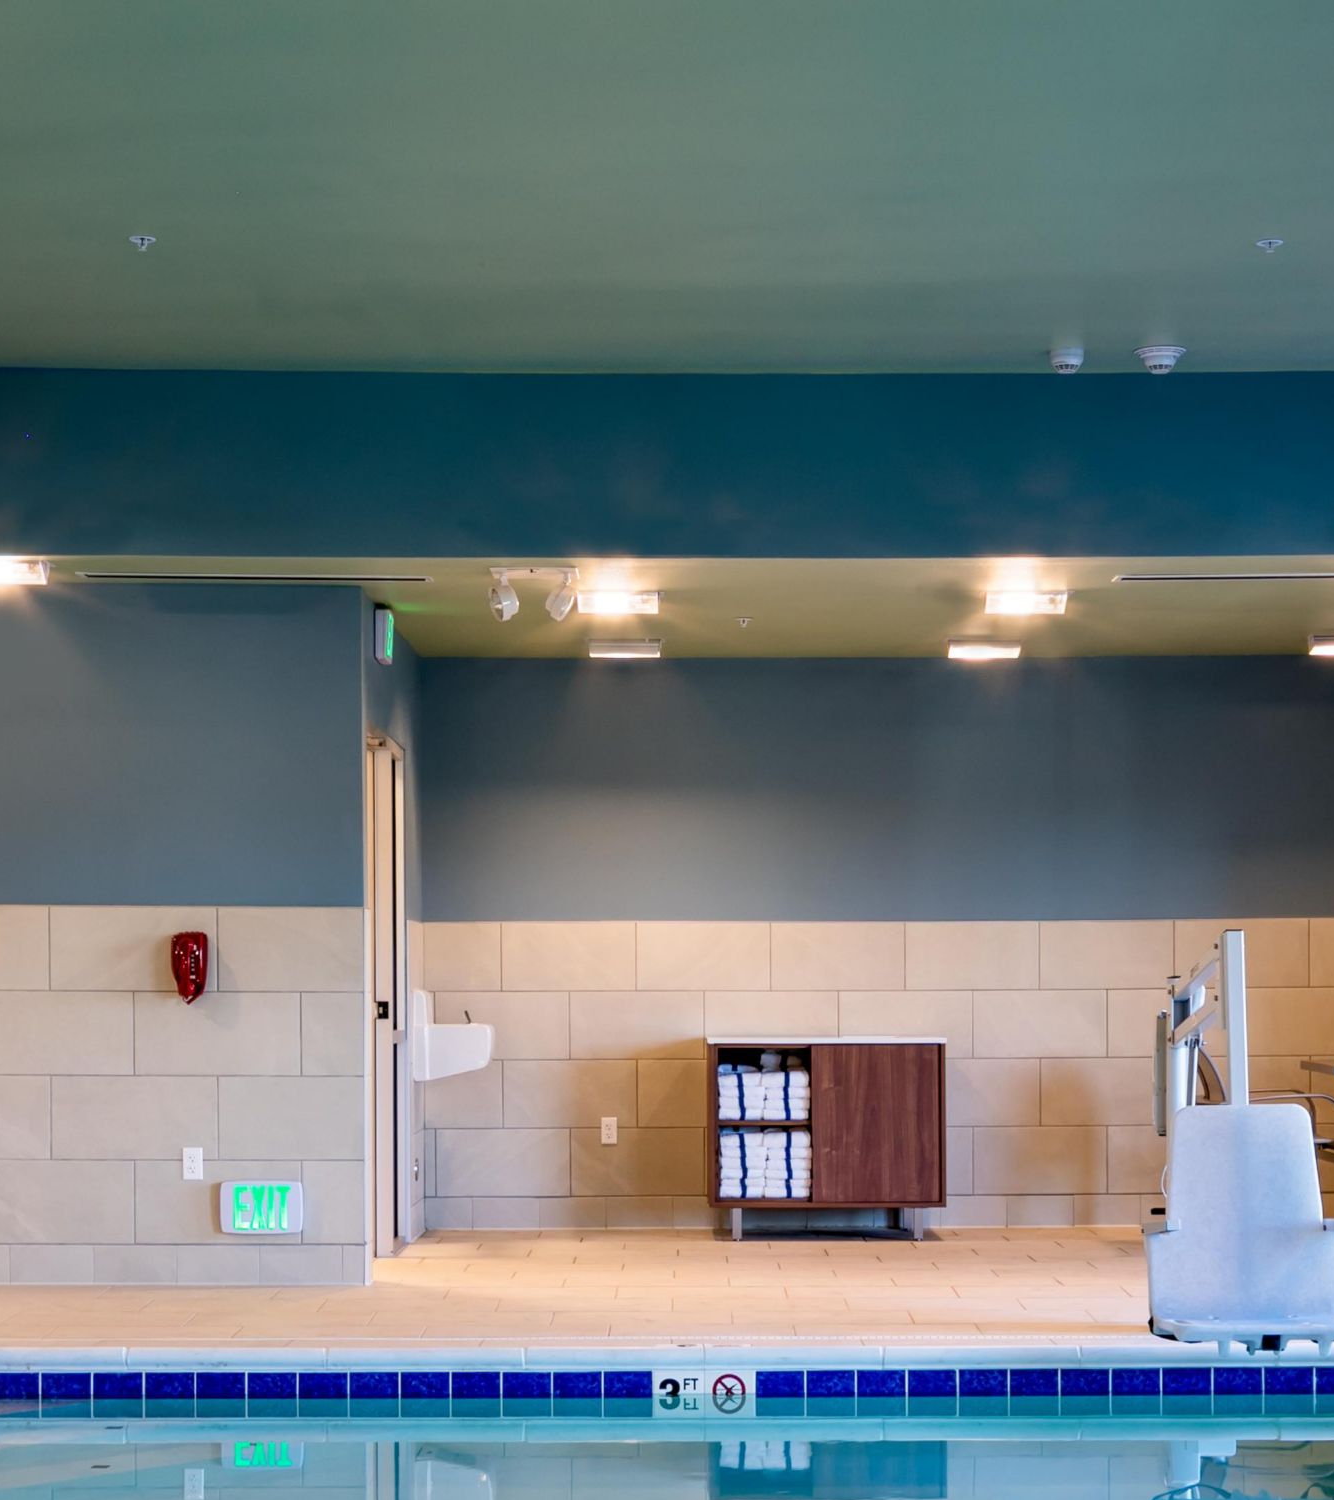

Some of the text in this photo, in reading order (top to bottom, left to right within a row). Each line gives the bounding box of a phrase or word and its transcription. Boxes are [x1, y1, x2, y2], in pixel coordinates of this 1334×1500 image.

[233, 1184, 291, 1230] EXIT
[659, 1378, 699, 1397] 3 FT
